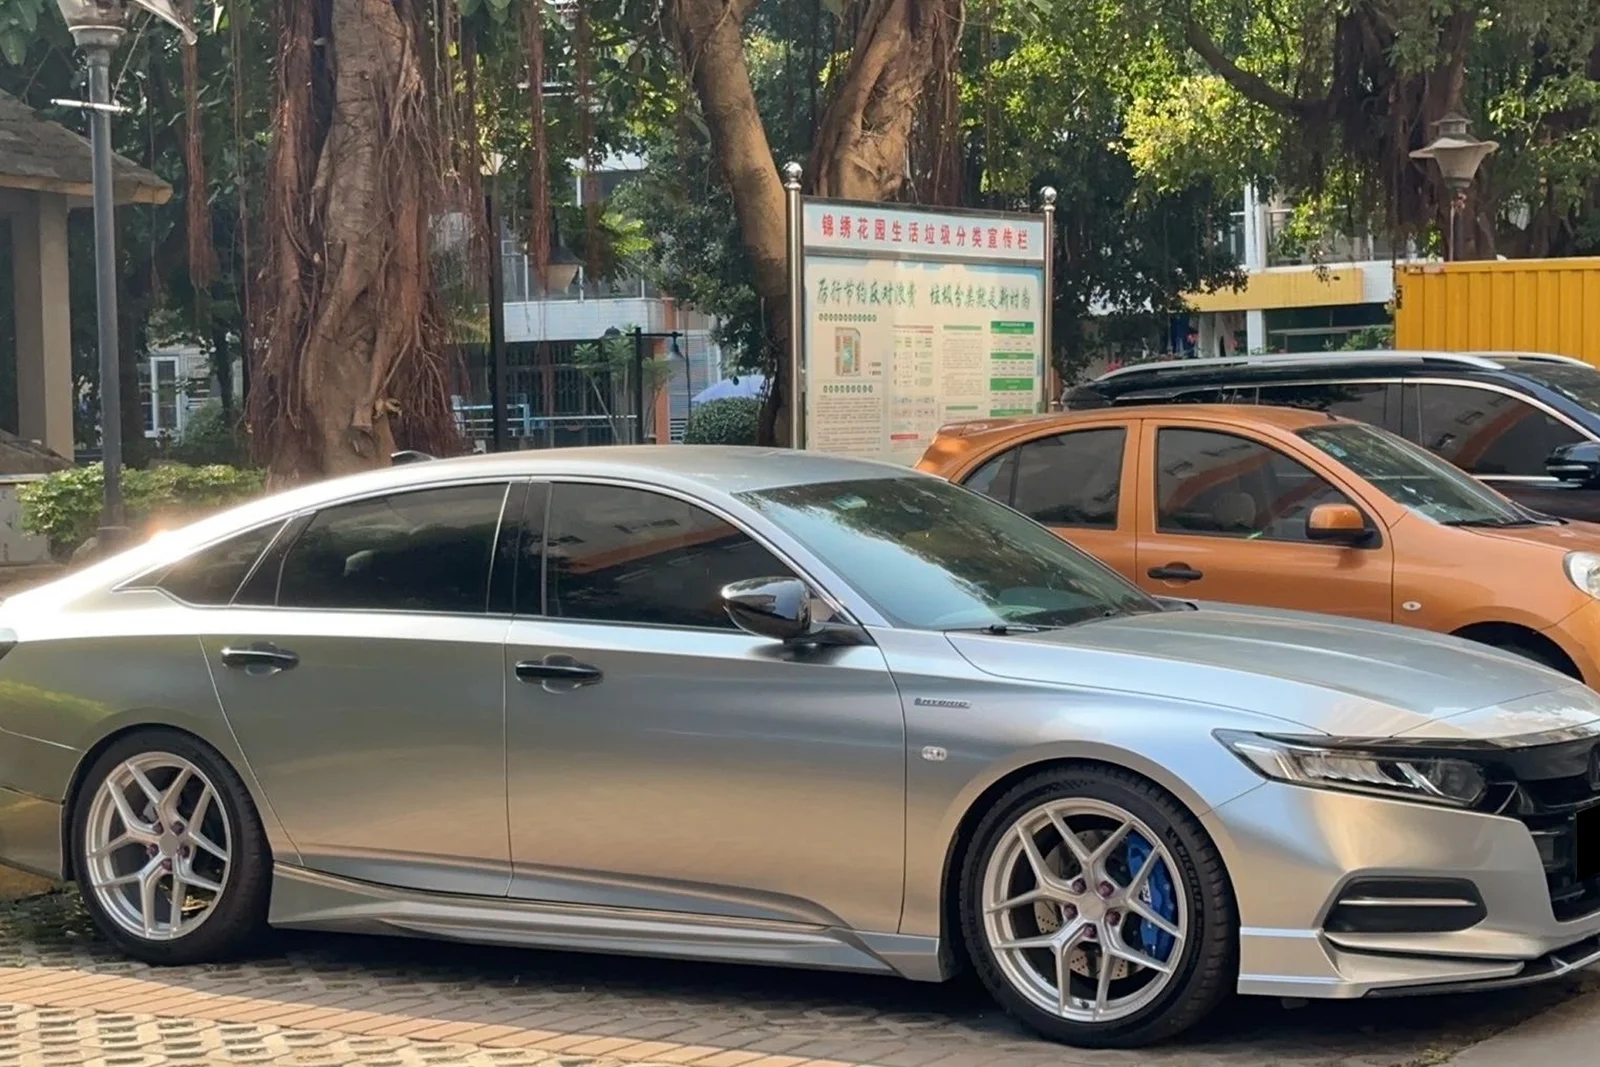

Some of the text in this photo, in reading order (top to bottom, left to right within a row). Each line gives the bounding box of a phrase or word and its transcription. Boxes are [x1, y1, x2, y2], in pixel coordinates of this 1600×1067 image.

[822, 214, 1028, 249] 锦绣花园生活垃圾分类宣传栏
